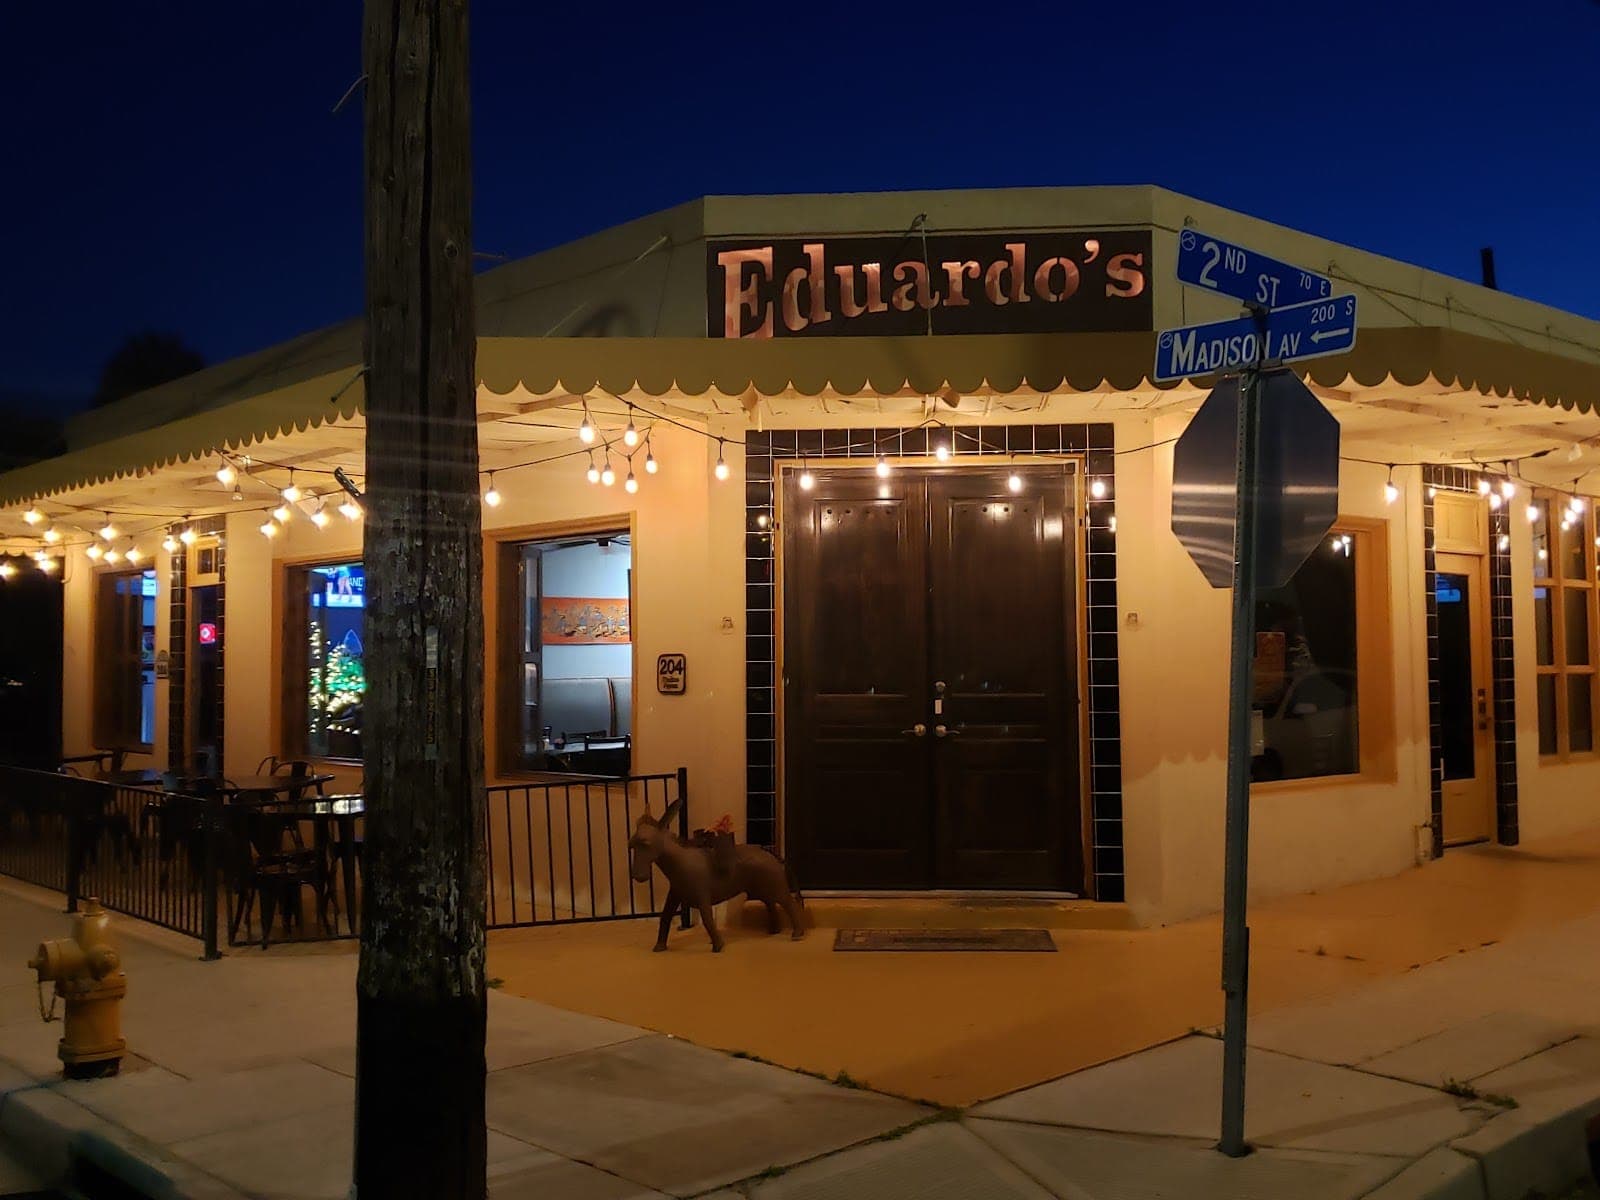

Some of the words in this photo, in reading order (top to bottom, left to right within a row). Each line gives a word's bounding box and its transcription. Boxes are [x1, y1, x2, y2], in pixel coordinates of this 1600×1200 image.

[1199, 241, 1247, 288] 2ND
[1256, 273, 1280, 306] ST
[717, 239, 1146, 339] Eduardo's
[1320, 280, 1327, 296] E
[1310, 304, 1336, 325] 200
[1345, 299, 1353, 316] S
[1278, 331, 1301, 358] AV
[660, 658, 683, 675] 204
